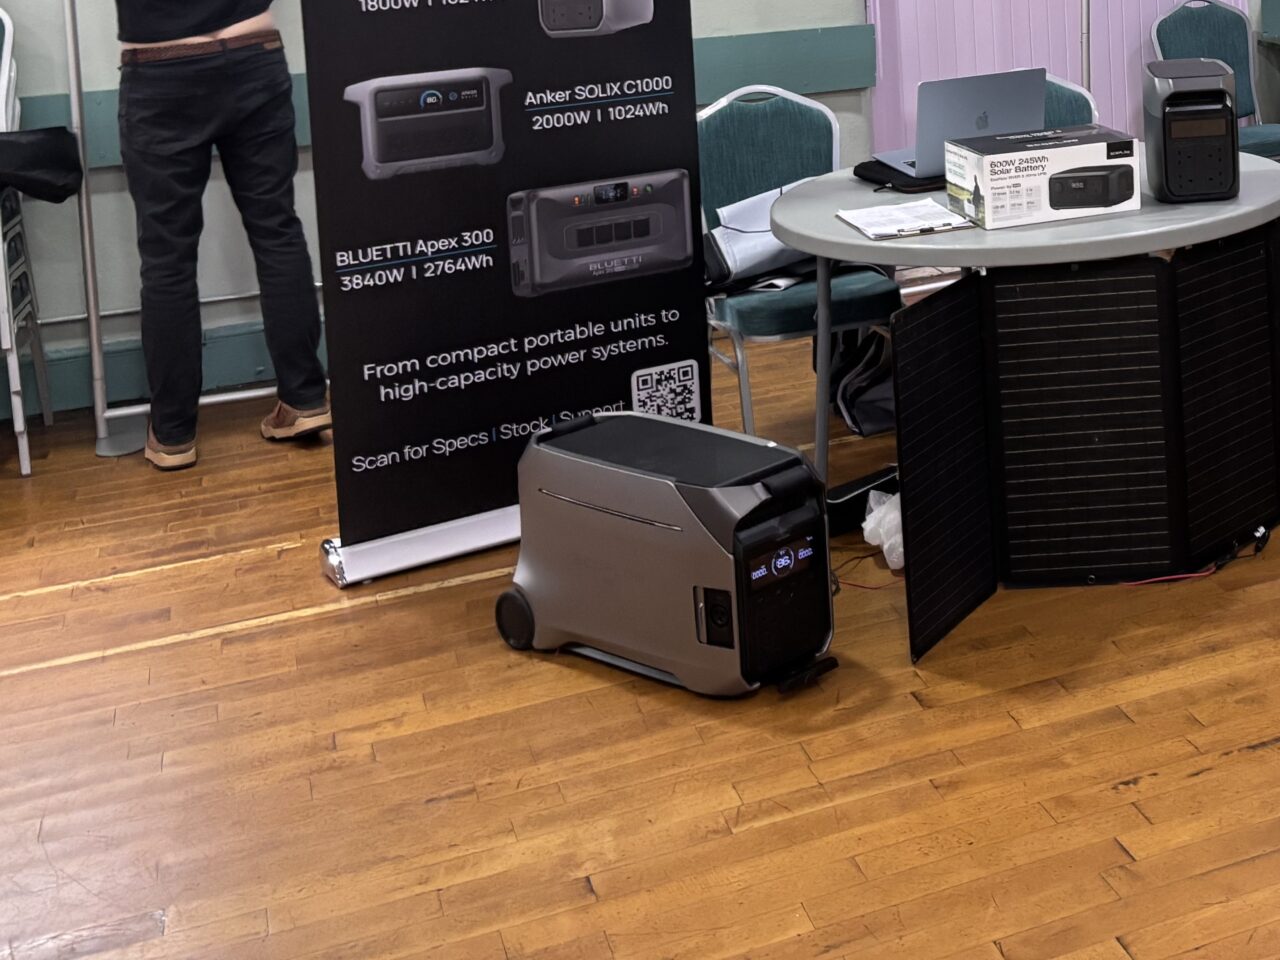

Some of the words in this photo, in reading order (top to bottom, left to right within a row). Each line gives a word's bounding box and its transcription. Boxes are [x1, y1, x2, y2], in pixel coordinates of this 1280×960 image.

[524, 90, 571, 106] Anker
[574, 82, 621, 100] SOLIX
[623, 76, 673, 94] C1000
[532, 110, 591, 130] 2000W
[608, 101, 669, 121] 1024Wh
[990, 159, 1016, 168] 600W
[1018, 156, 1048, 165] 245Wh
[990, 168, 1012, 176] Solar
[1014, 164, 1046, 173] Battery
[335, 242, 411, 267] BLUETTI
[415, 236, 459, 256] Apex
[461, 229, 494, 247] 300
[590, 255, 642, 271] BLUETTI
[340, 267, 404, 291] 3840W
[423, 254, 494, 278] 2764Wh
[363, 359, 420, 381] From
[425, 338, 518, 369] compact
[523, 319, 605, 353] portable
[610, 311, 657, 334] units
[660, 307, 680, 323] to
[379, 361, 521, 402] high-capacity
[526, 346, 586, 376] power
[591, 332, 669, 361] systems.
[352, 450, 400, 472] Scan
[403, 442, 429, 462] for
[432, 430, 489, 457] Specs
[500, 417, 550, 440] Stock
